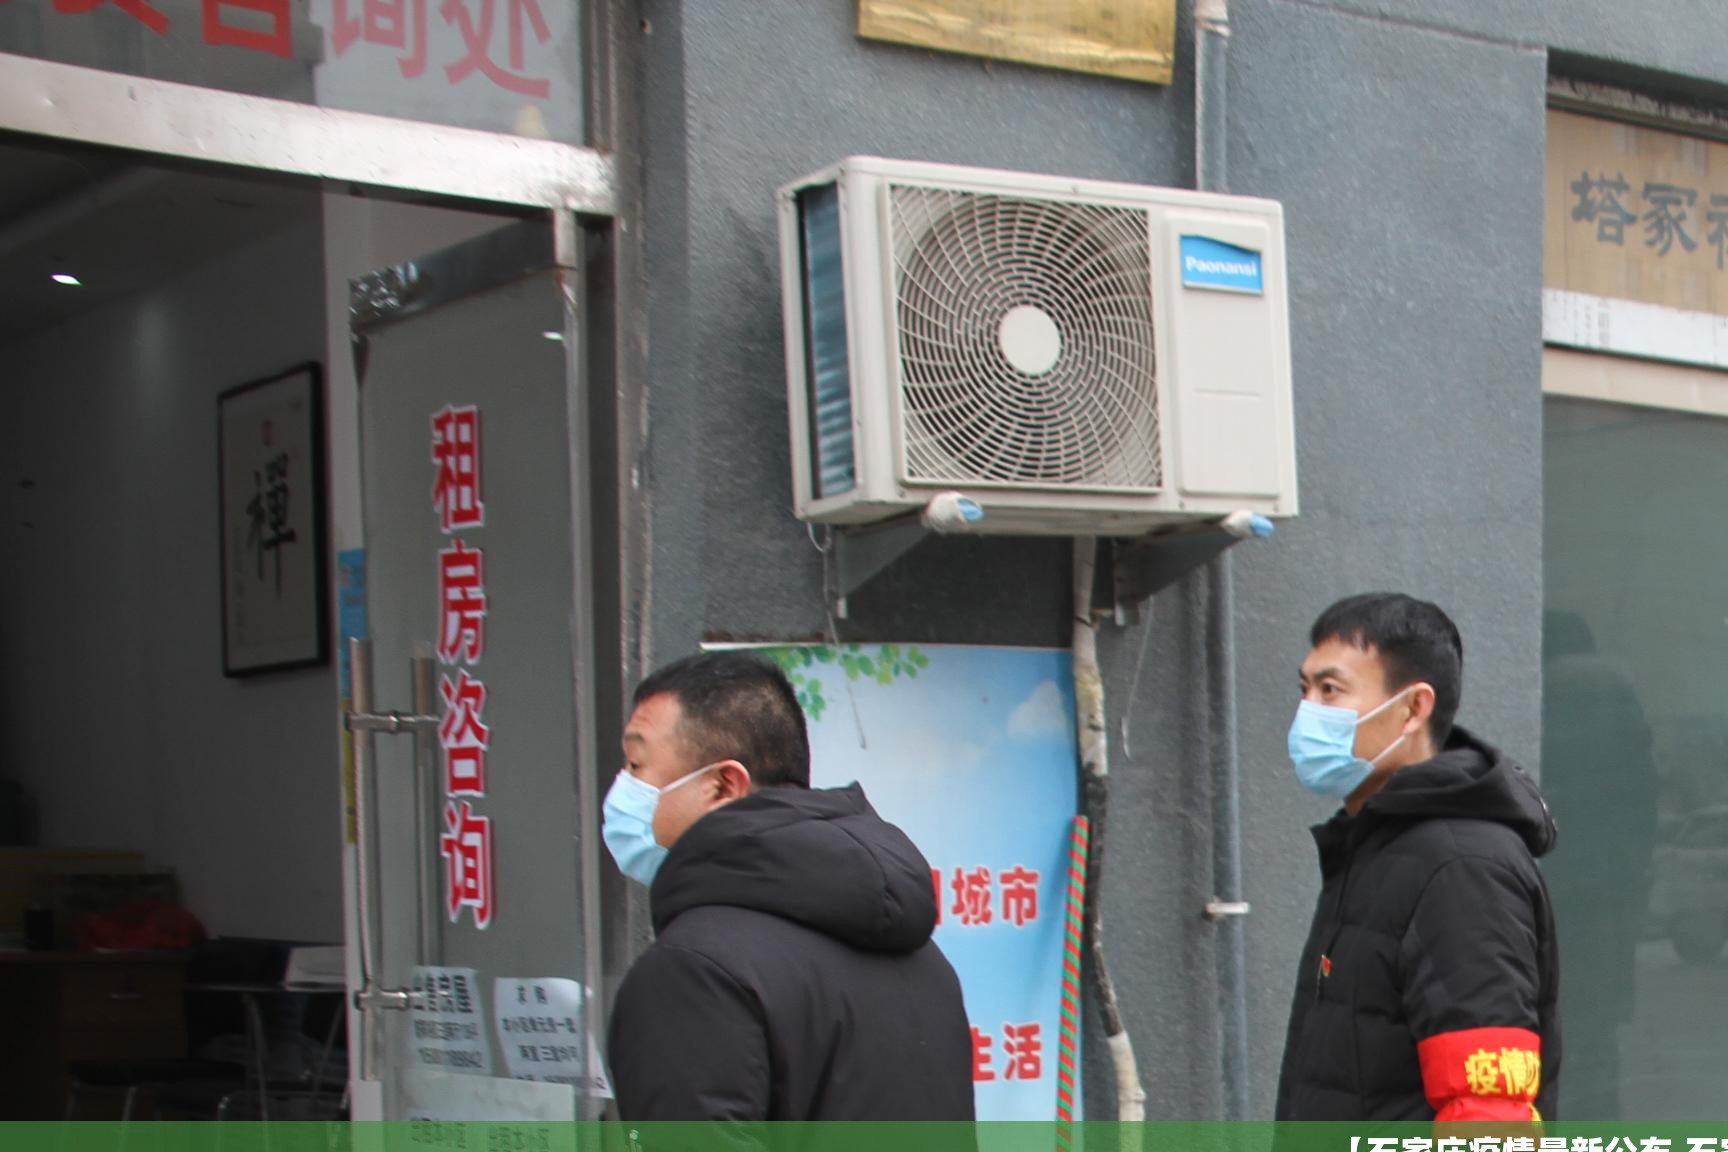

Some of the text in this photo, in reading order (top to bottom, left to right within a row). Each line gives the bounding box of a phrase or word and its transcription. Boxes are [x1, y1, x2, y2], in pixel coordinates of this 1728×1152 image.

[432, 403, 494, 930] 租房咨询
[931, 865, 1039, 927] 城市
